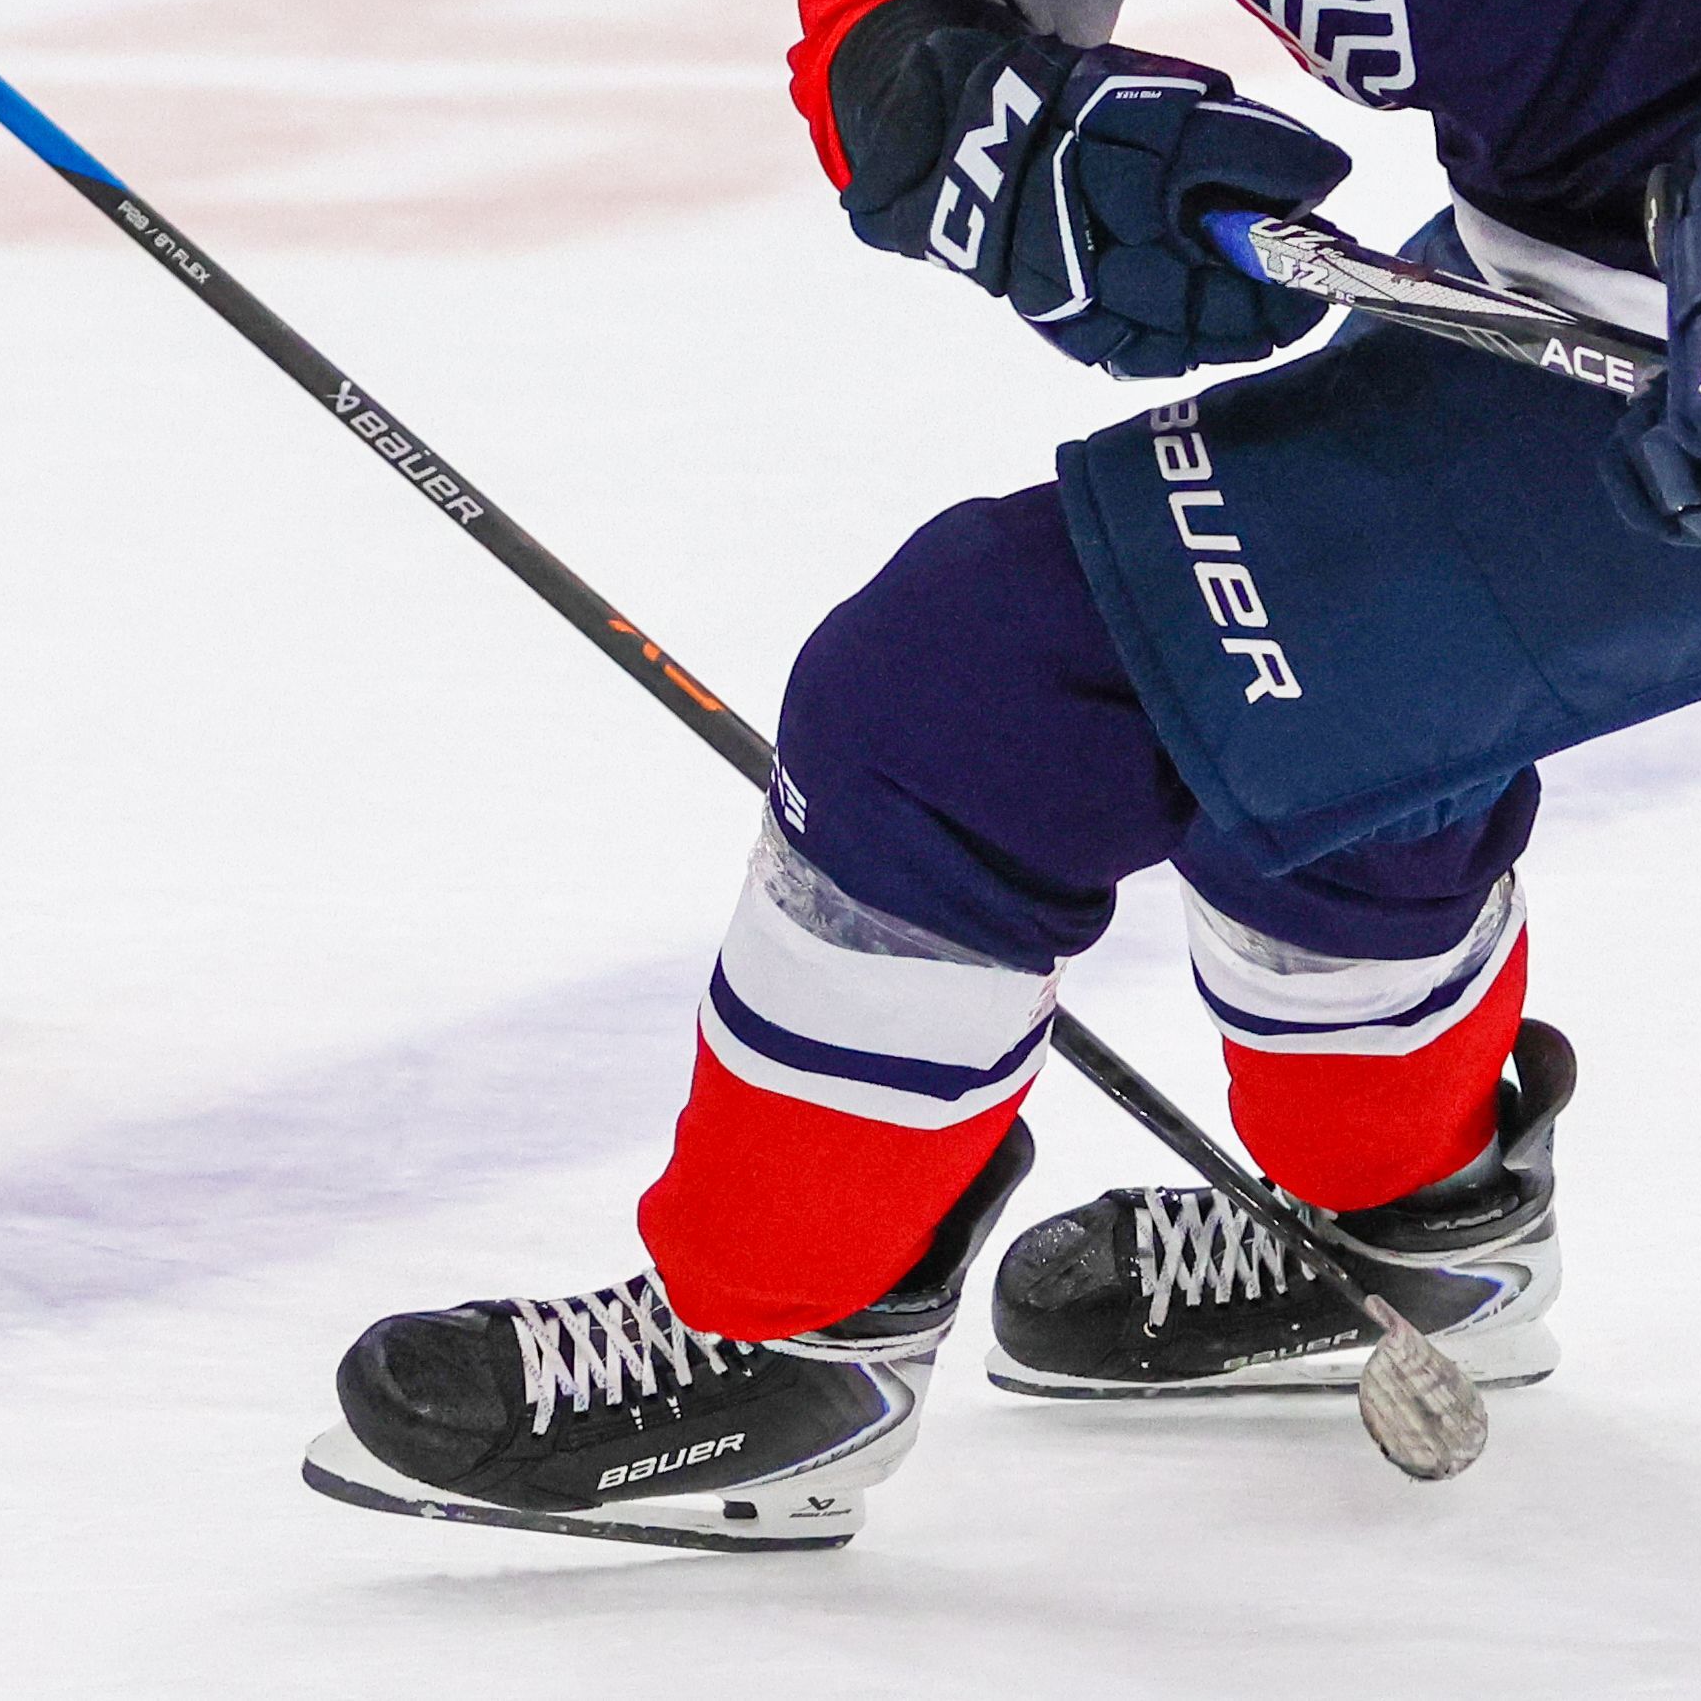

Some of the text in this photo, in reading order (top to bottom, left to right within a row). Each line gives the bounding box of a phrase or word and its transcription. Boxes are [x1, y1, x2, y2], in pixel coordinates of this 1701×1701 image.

[925, 66, 1043, 270] CM
[1538, 337, 1636, 393] ACE
[349, 410, 484, 525] BAUER
[1148, 398, 1303, 706] BAUER
[597, 1431, 746, 1491] BAUER
